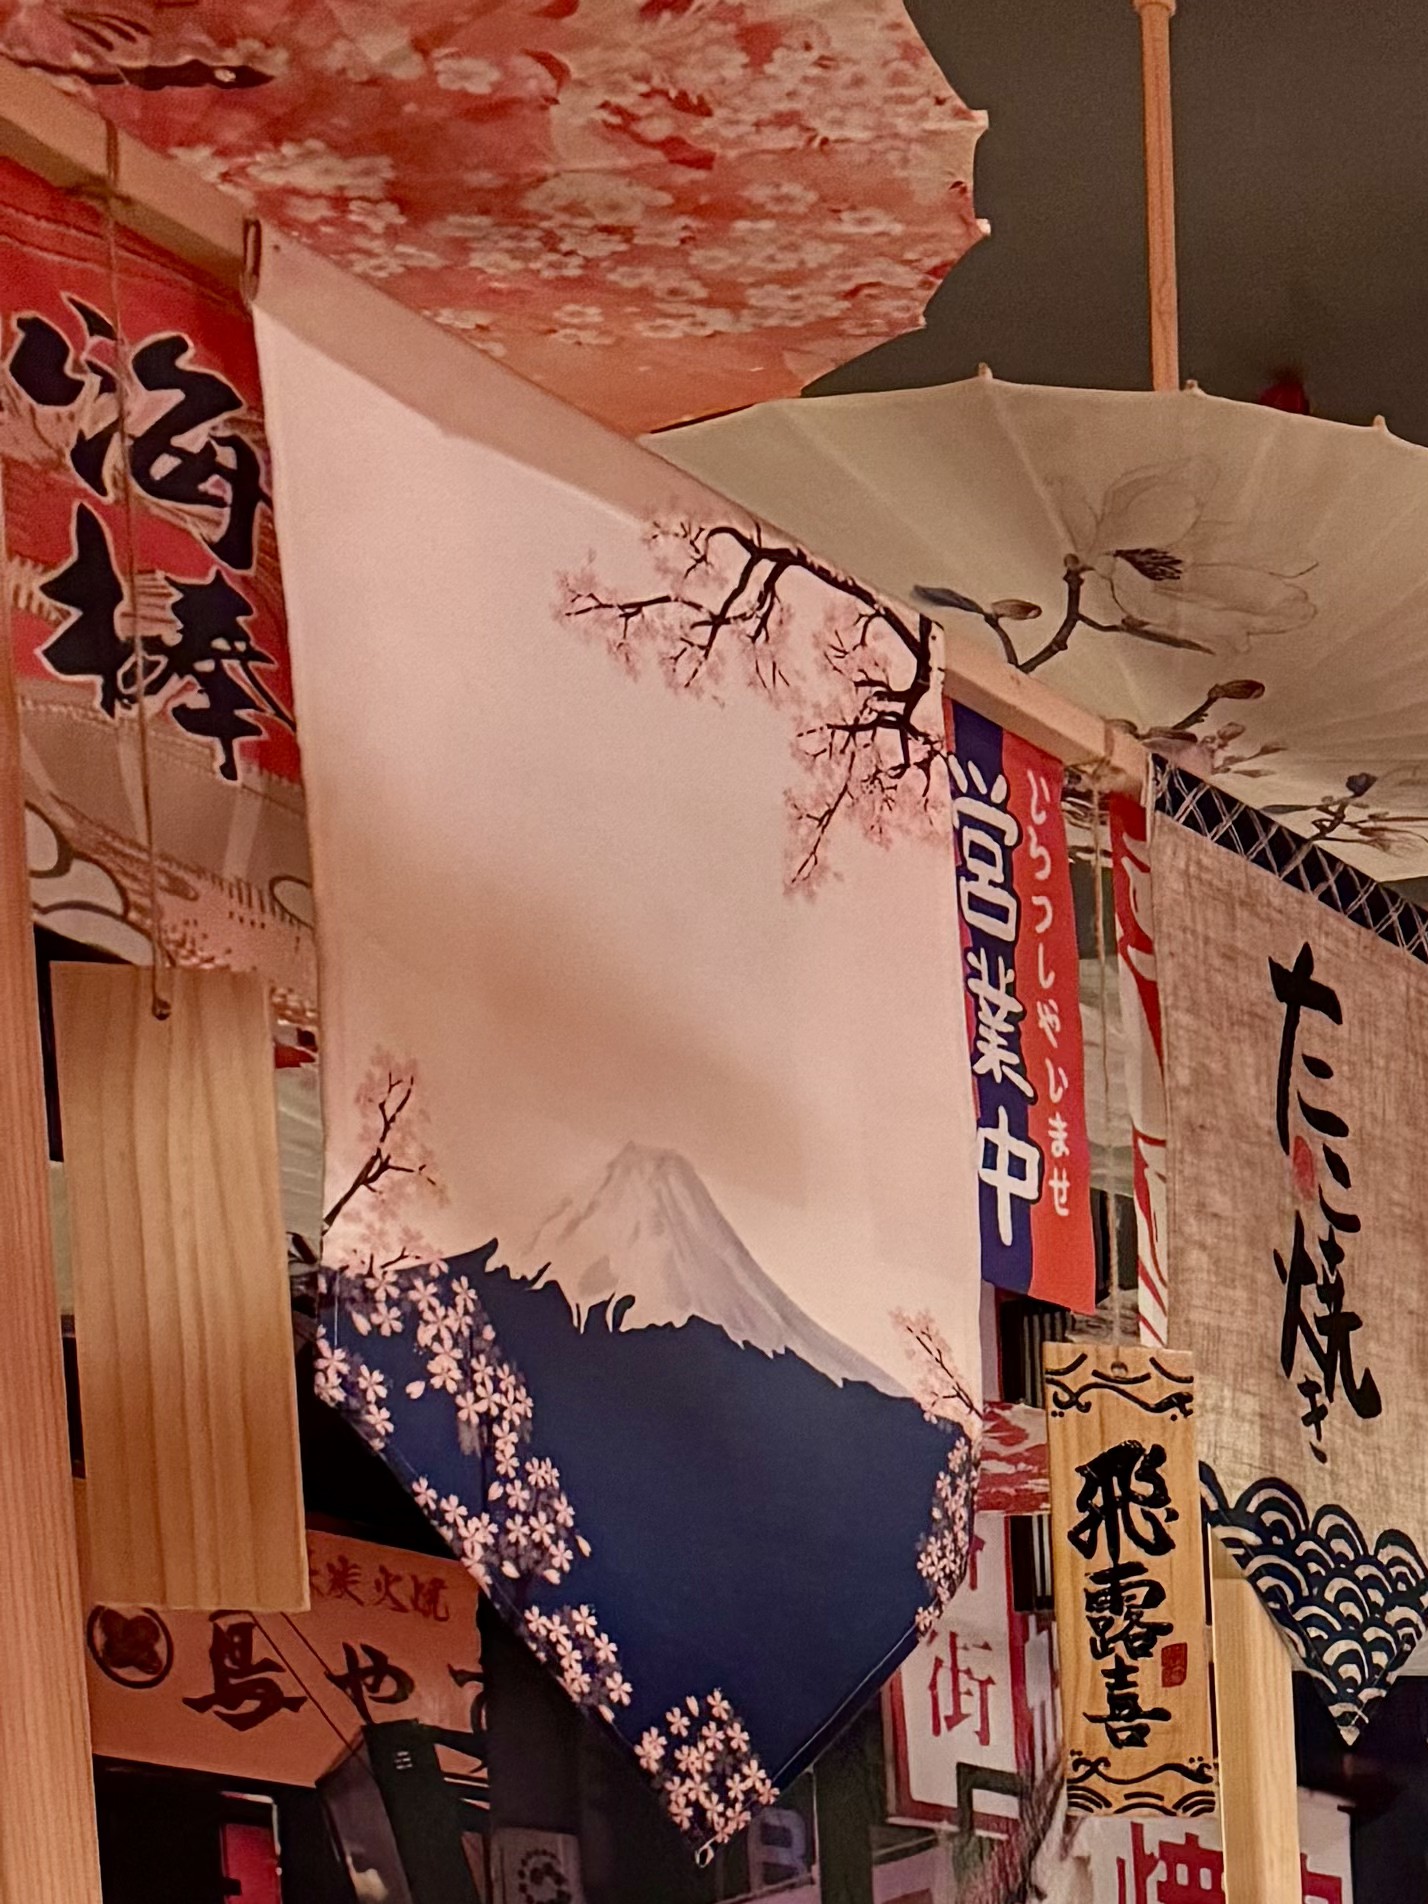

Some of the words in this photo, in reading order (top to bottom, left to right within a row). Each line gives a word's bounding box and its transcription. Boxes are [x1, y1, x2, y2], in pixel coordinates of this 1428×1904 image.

[950, 755, 1041, 1247] 営業中
[183, 1608, 486, 1770] 鳥や
[1068, 1439, 1178, 1751] 飛露喜
